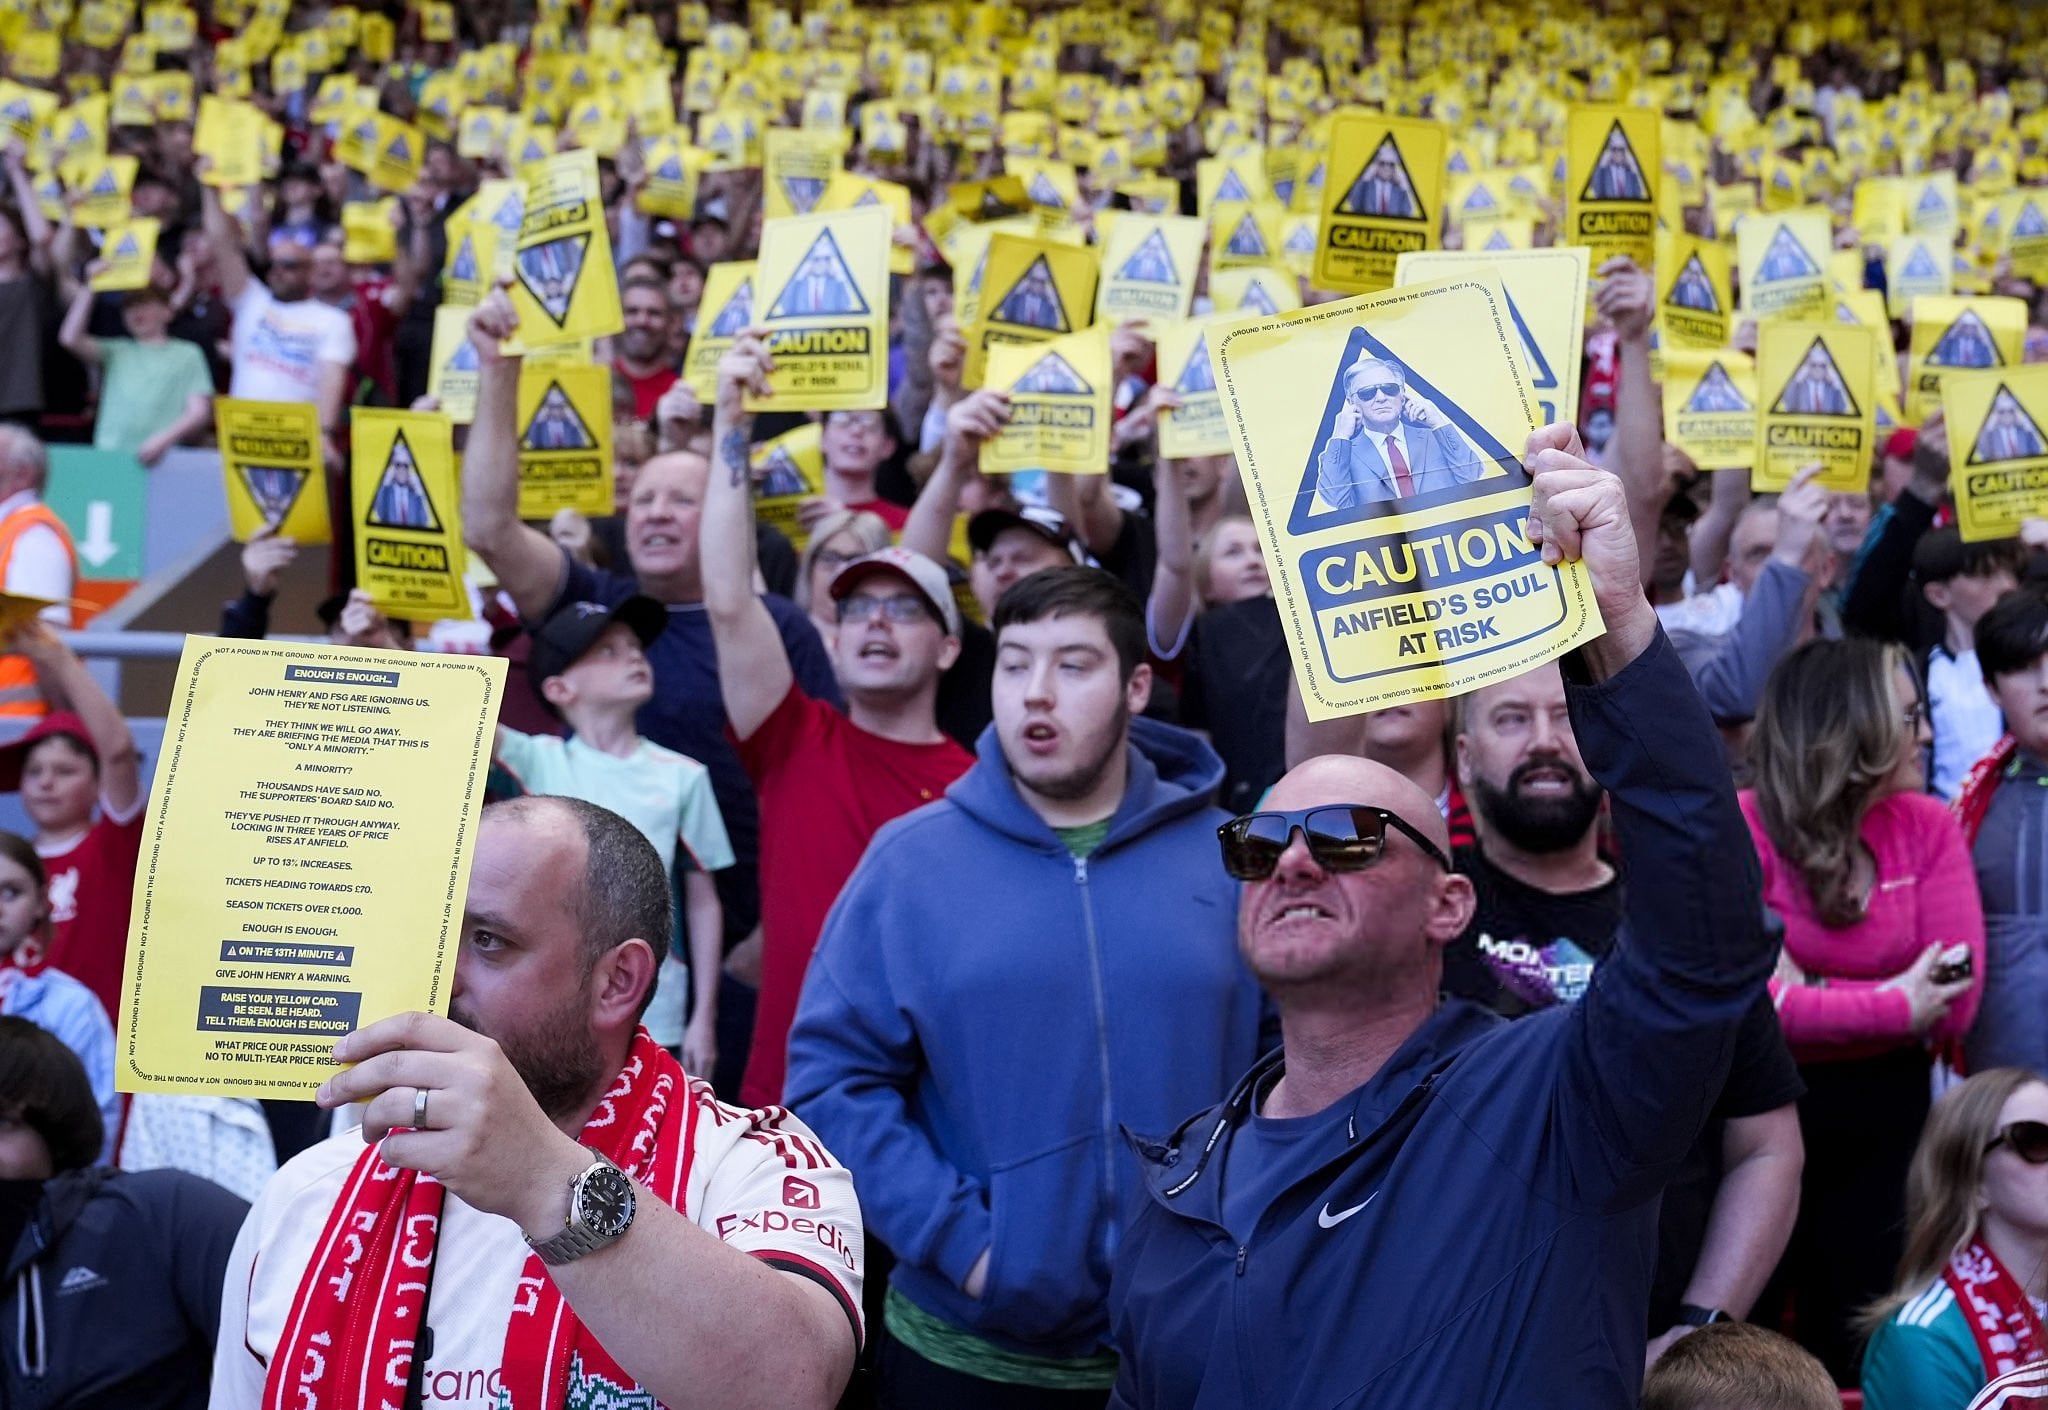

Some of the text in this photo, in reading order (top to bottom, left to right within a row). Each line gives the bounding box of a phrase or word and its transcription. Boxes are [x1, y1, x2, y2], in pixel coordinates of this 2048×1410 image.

[1231, 326, 1259, 337] GROUND
[1281, 318, 1303, 328] POUND
[1312, 313, 1325, 321] THE
[1325, 307, 1353, 318] GROUND
[1355, 303, 1369, 311] NOT
[1376, 297, 1398, 306] POUND
[1420, 287, 1447, 297] GROUND
[1970, 468, 2048, 497] CAUTIO
[1316, 517, 1534, 595] CAUTION
[1332, 572, 1548, 638] ANFIELD'S SOUL
[1398, 617, 1499, 657] AT RISK
[294, 668, 334, 679] ENOUGH
[335, 671, 345, 680] IS
[476, 666, 488, 678] THE
[483, 672, 492, 704] GROUND
[248, 687, 429, 706] JOHN HENRY AND FSG ARE IGNORING US.
[283, 700, 391, 714] THEY'RE NOT LISTENING.
[265, 719, 400, 736] THEY THINK WE WILL GO AWAY.
[233, 727, 429, 748] THEY ARE BRIEFING THE MEDIA THAT THIS IS
[303, 764, 352, 774] MINORITY?
[256, 781, 382, 797] THOUSANDS HAVE SAID NO.
[239, 790, 258, 799] THE
[320, 796, 352, 805] BOARD
[354, 798, 376, 807] SAID
[377, 800, 394, 808] NO.
[224, 811, 261, 820] THEY'VE
[262, 813, 300, 823] PUSHED
[312, 816, 358, 827] THROUGH
[359, 820, 400, 830] ANYWAY.
[231, 822, 272, 832] LOCKING
[286, 825, 316, 835] THREE
[318, 828, 346, 837] YEARS
[362, 830, 389, 839] PRICE
[265, 835, 348, 848] RISES AT ANFIELD.
[253, 856, 352, 870] UP TO 13% INCREASES.
[225, 877, 372, 893] TICKETS HEADING TOWARDS £70.
[225, 899, 362, 915] SEASON TICKETS OVER £1,000.
[242, 923, 337, 936] ENOUGH IS ENOUGH.
[238, 946, 334, 959] ON THE 13TH MINUTE
[215, 969, 350, 982] GIVE JOHN HENRY A WARNING.
[220, 992, 338, 1006] RAISE YOUR YELLOW CARD.
[233, 1004, 322, 1017] BE SEEN. BE HEARD.
[204, 1015, 349, 1030] TELL THEM: ENOUGH IS ENOUGH
[214, 1040, 333, 1053] WHAT PRICE OUR PASSION?
[205, 1052, 341, 1066] NO TO MULTI-YEAR PRICE RISES
[716, 1210, 855, 1271] Expedia
